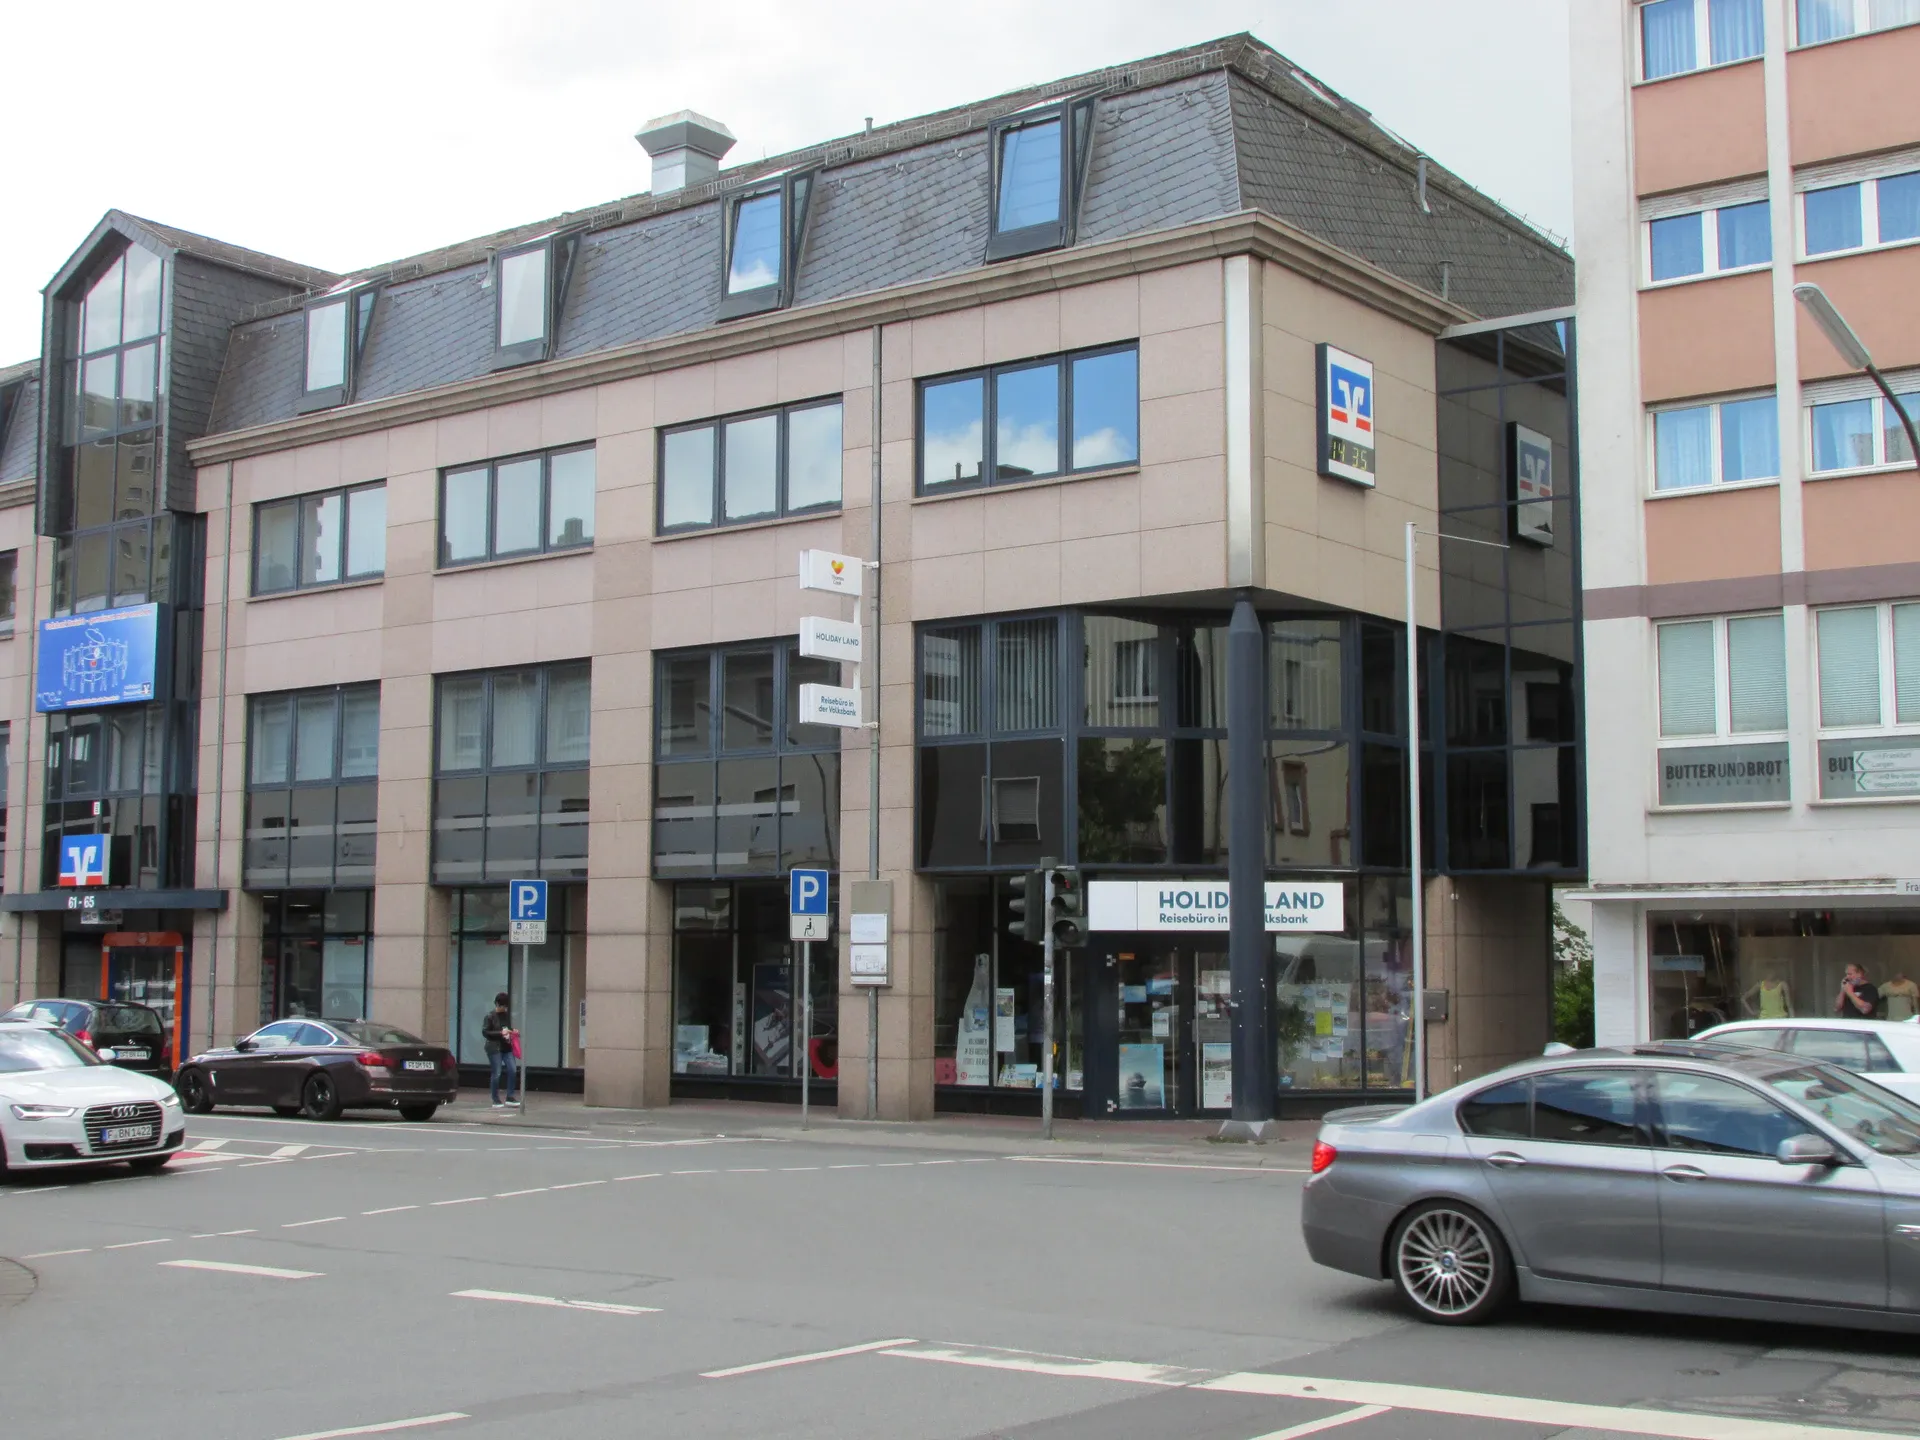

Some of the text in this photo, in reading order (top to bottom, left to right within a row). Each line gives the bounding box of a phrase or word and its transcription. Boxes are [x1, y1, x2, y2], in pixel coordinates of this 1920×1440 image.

[1352, 446, 1368, 472] 35
[815, 632, 860, 647] HOLIDAY LAND
[820, 695, 848, 707] Reisebüro
[818, 704, 857, 717] der Volksbank
[799, 875, 820, 911] P
[1159, 890, 1325, 910] HOLID LAND
[67, 896, 78, 909] 61
[83, 895, 95, 909] 65
[518, 885, 539, 918] P
[1159, 912, 1309, 924] Reisebüro in lksbank
[107, 1126, 151, 1139] F BN 1422
